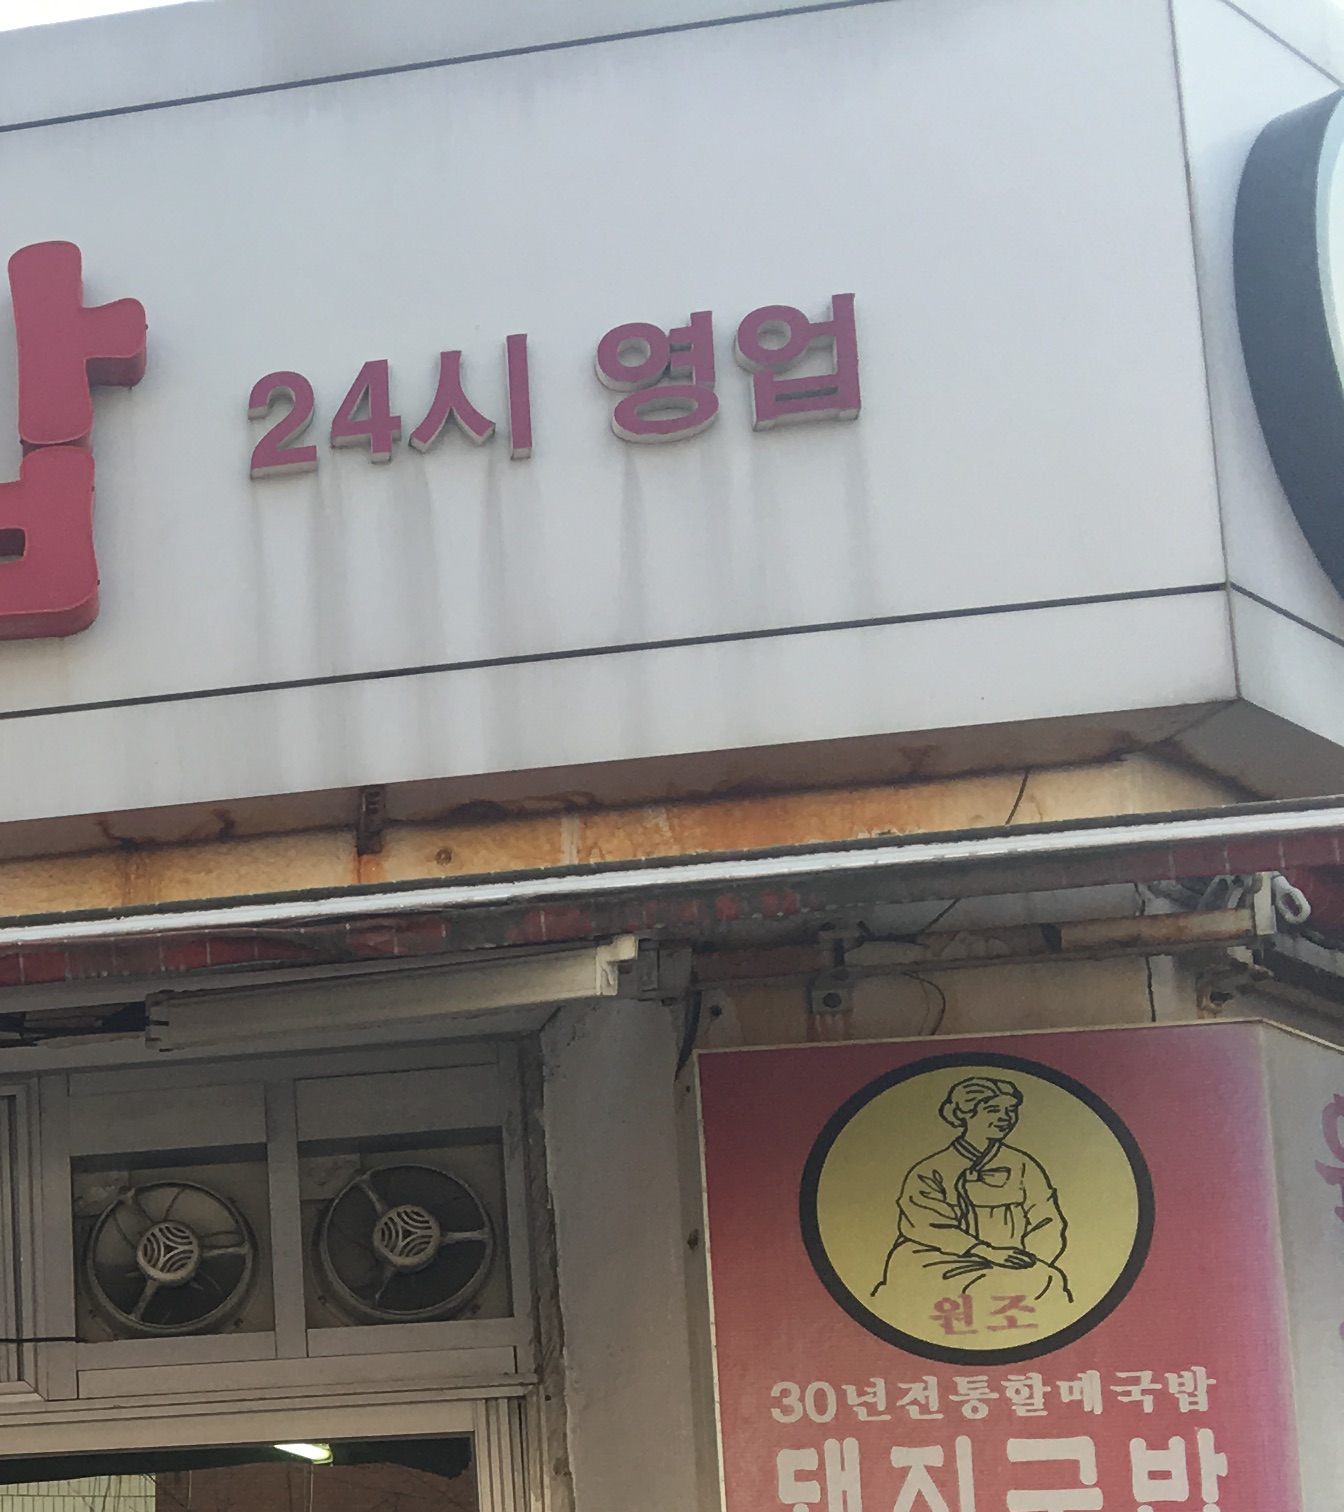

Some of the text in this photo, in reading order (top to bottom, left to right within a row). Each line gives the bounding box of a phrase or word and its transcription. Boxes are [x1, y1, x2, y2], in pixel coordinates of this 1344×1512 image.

[247, 292, 862, 481] 24시 영업
[929, 1294, 1040, 1336] 원조
